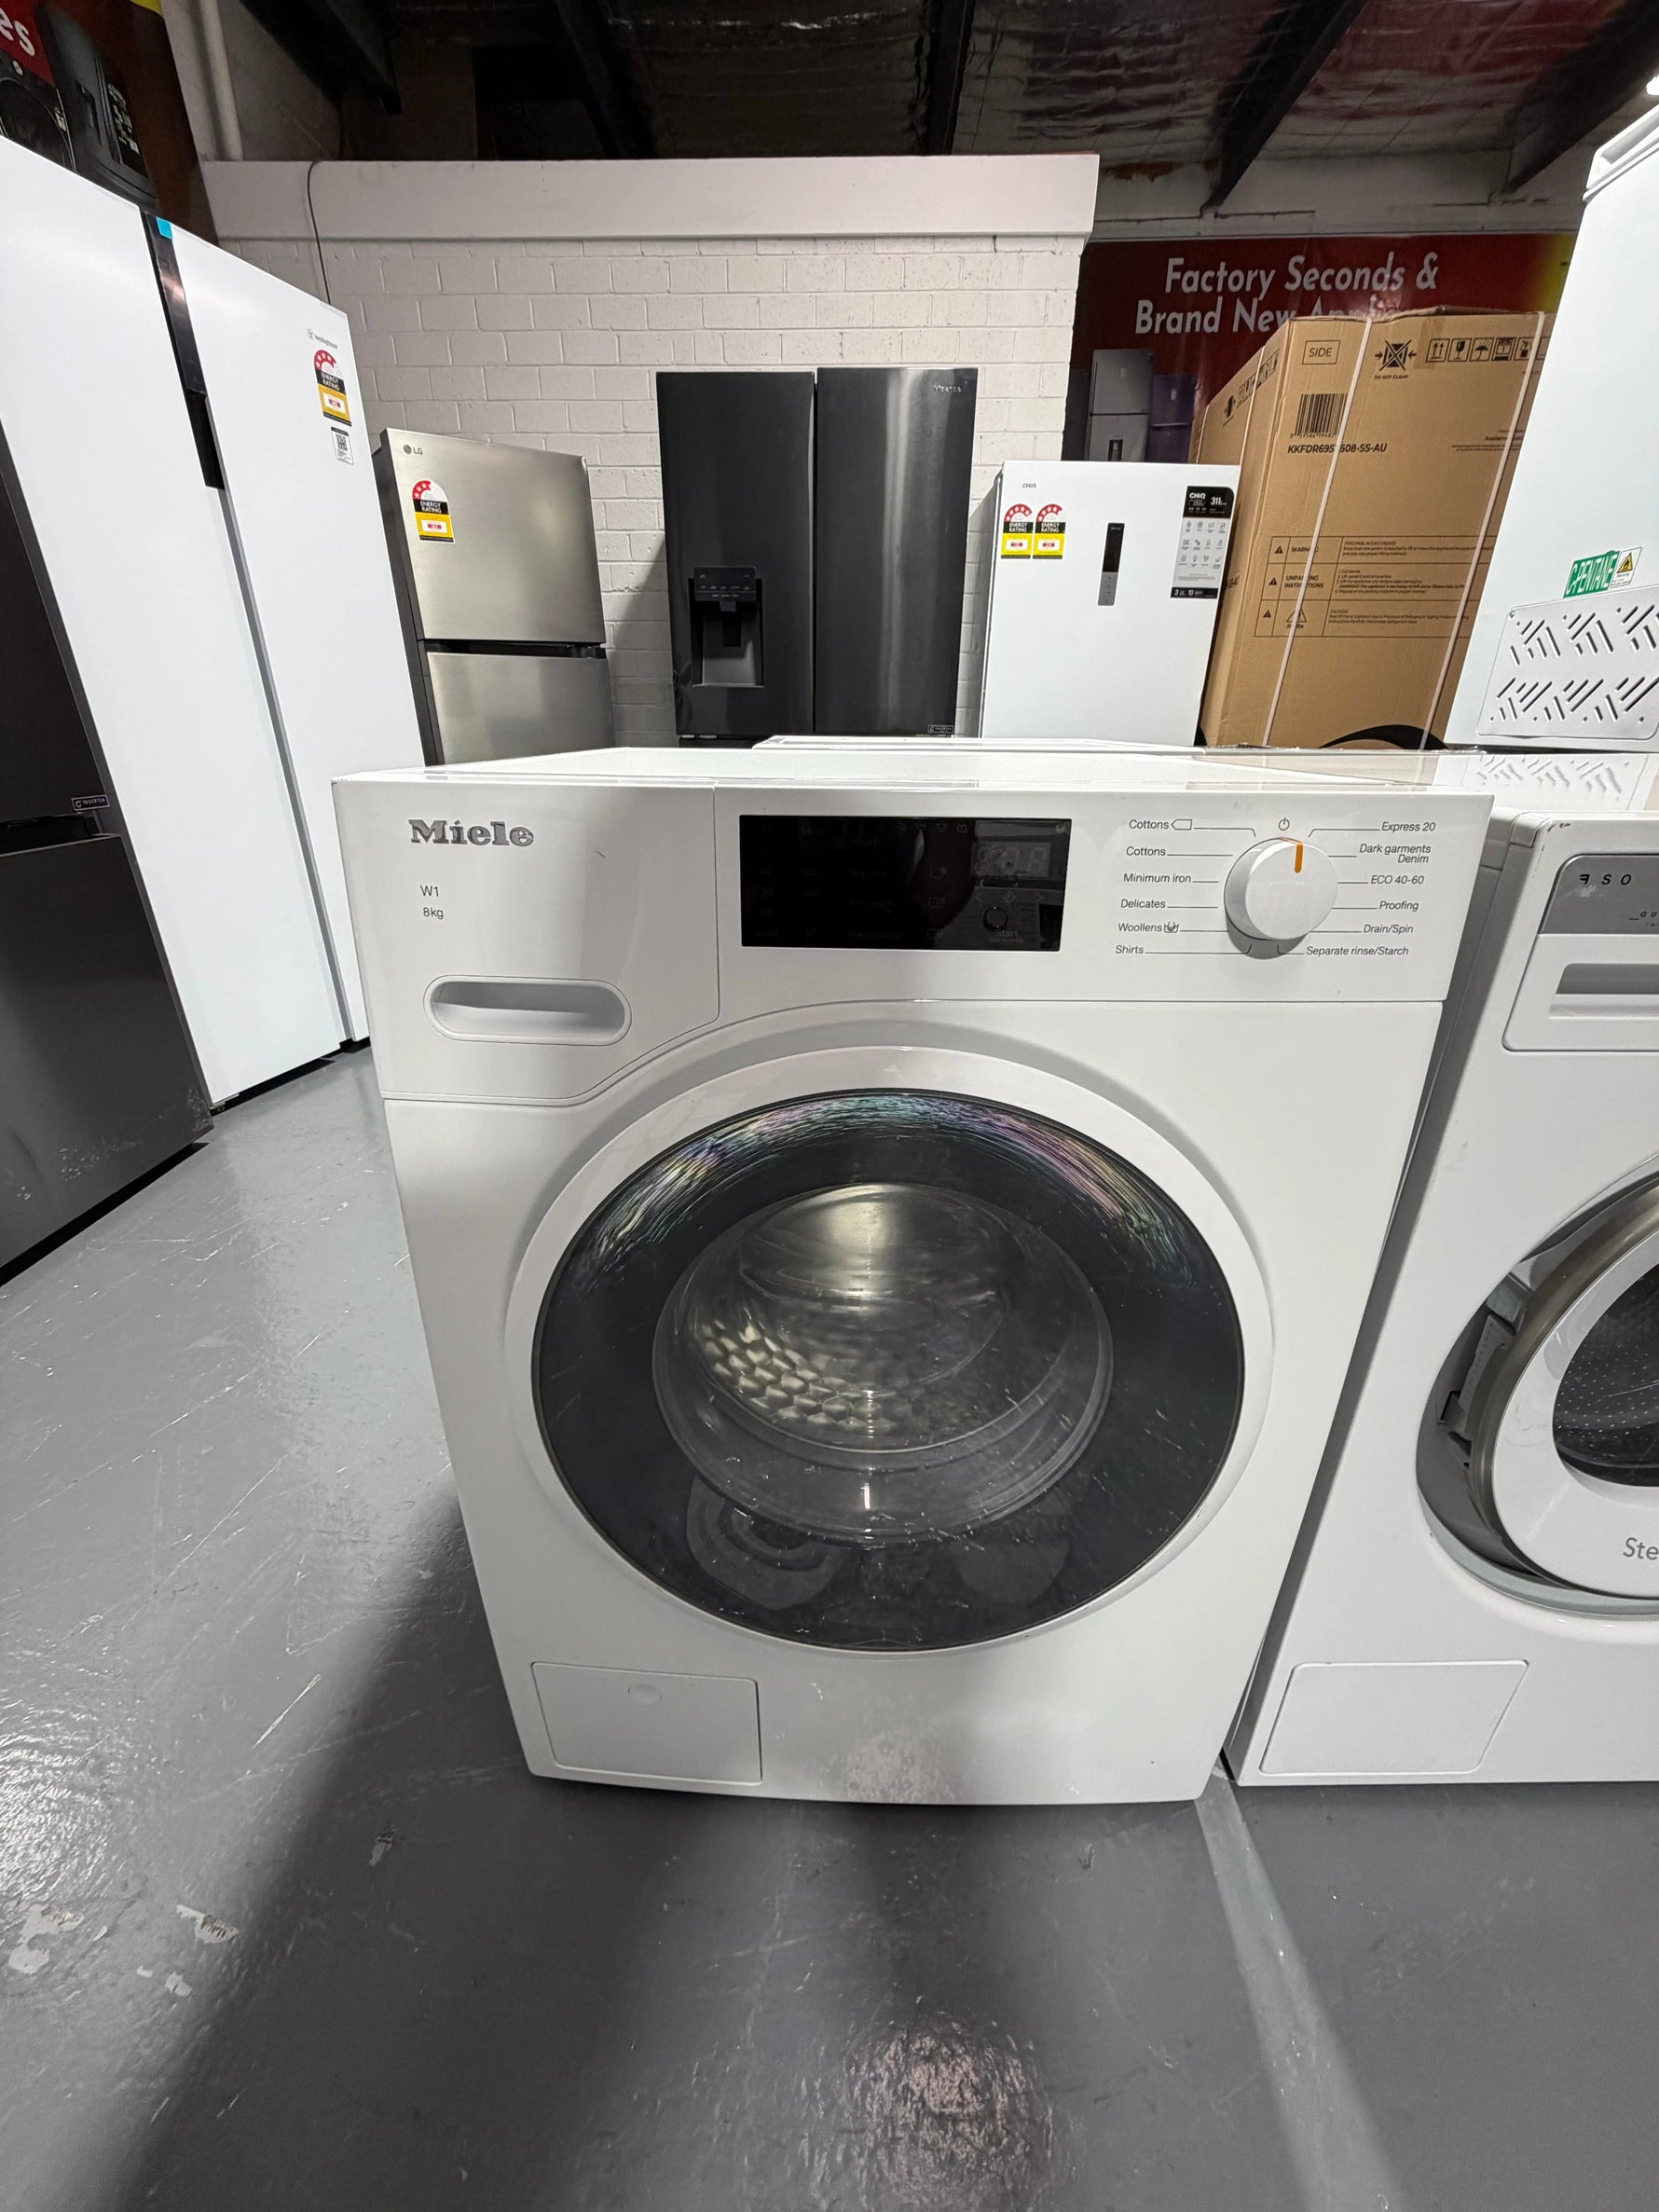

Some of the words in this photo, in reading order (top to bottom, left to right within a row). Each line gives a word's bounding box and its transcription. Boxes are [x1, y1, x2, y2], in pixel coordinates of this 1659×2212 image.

[1165, 256, 1276, 301] Factory
[1283, 251, 1405, 292] Seconds
[1416, 251, 1439, 290] &
[1134, 295, 1224, 335] Brand
[1308, 347, 1334, 358] SIDE
[413, 447, 423, 455] LG
[419, 501, 442, 509] ENERGY
[1129, 818, 1169, 830] Cottons
[1381, 821, 1420, 833] Express
[1422, 821, 1436, 831] 20
[408, 819, 534, 846] Miele
[1126, 845, 1166, 857] Cottons
[1359, 843, 1383, 854] Dark
[1384, 845, 1432, 855] garments
[1397, 854, 1430, 863] Denim
[1123, 872, 1171, 883] Minimum
[1172, 872, 1192, 883] iron
[1370, 874, 1393, 885] ECO
[1394, 874, 1425, 885] 40-60
[420, 885, 439, 897] W1
[1120, 899, 1166, 909] Delicates
[1379, 900, 1419, 912] Proofing
[422, 907, 444, 920] 8kg
[1117, 922, 1162, 932] Woollens
[1364, 924, 1414, 935] Drain/Spin
[1115, 944, 1145, 955] Shirts
[1306, 945, 1350, 956] Separate
[1351, 945, 1409, 955] rinse/Starch
